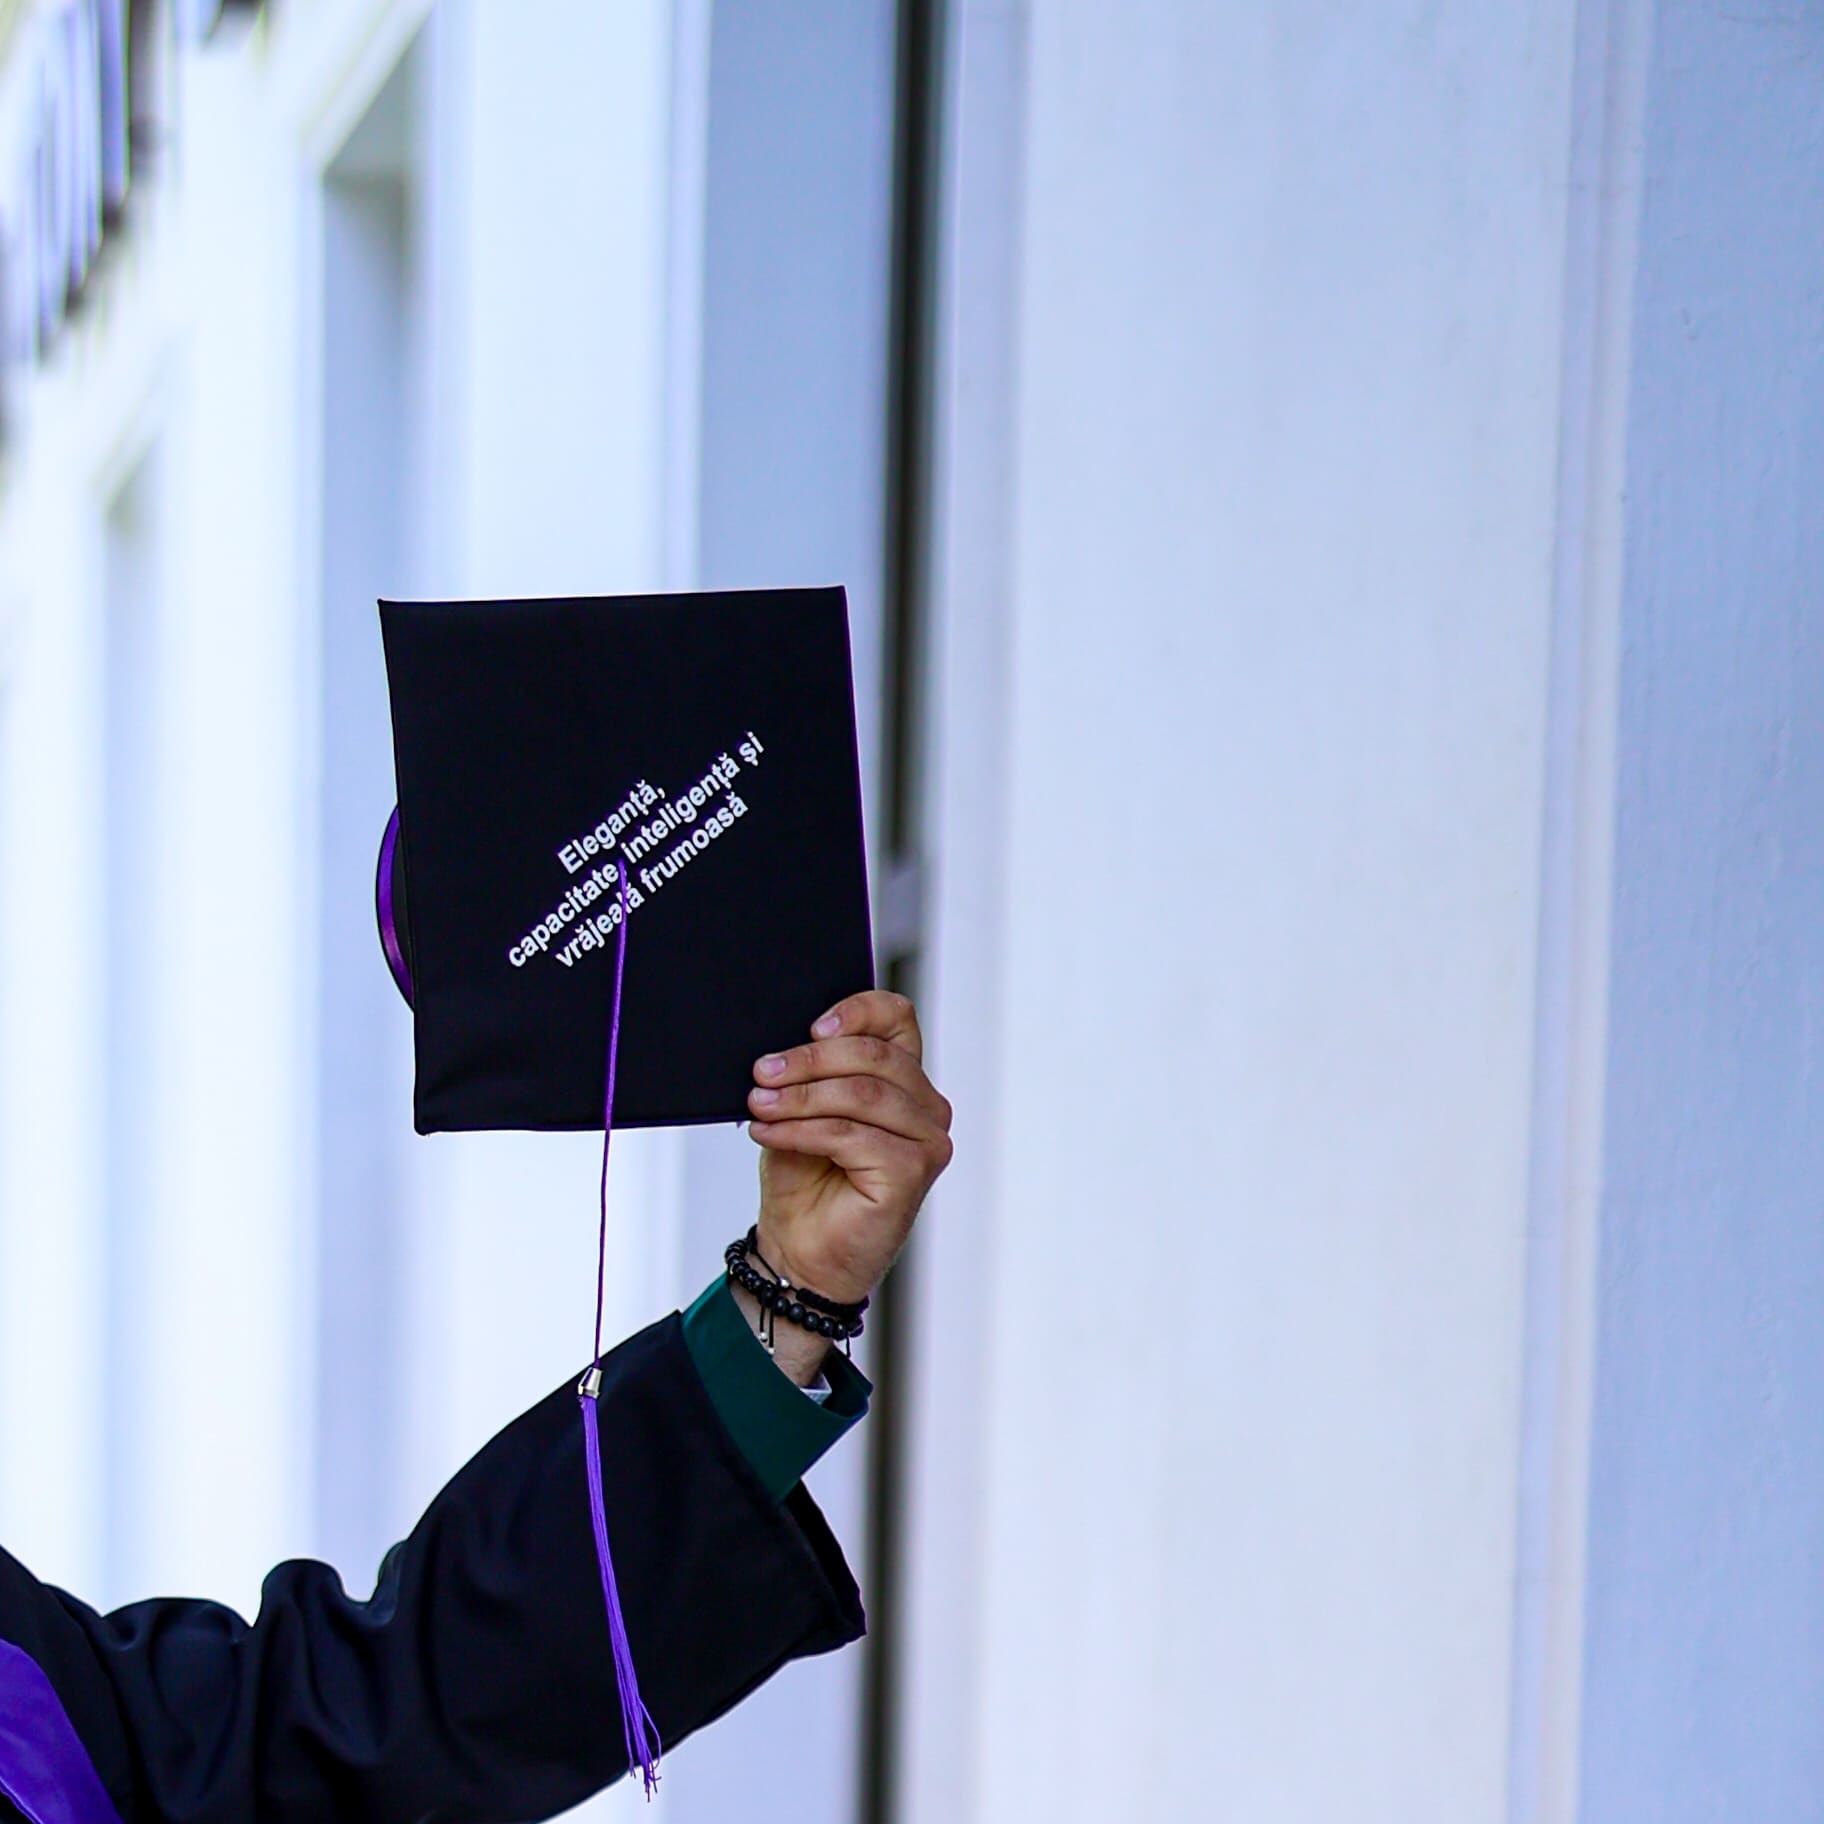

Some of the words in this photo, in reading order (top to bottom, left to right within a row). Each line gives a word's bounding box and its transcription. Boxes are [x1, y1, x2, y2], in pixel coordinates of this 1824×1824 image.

[508, 863, 627, 967] capacitate
[620, 752, 741, 864] inteligență
[739, 731, 764, 766] și
[555, 882, 645, 967] vrăjeală
[639, 791, 749, 893] frumoasă
[557, 779, 666, 874] Eleganță,
